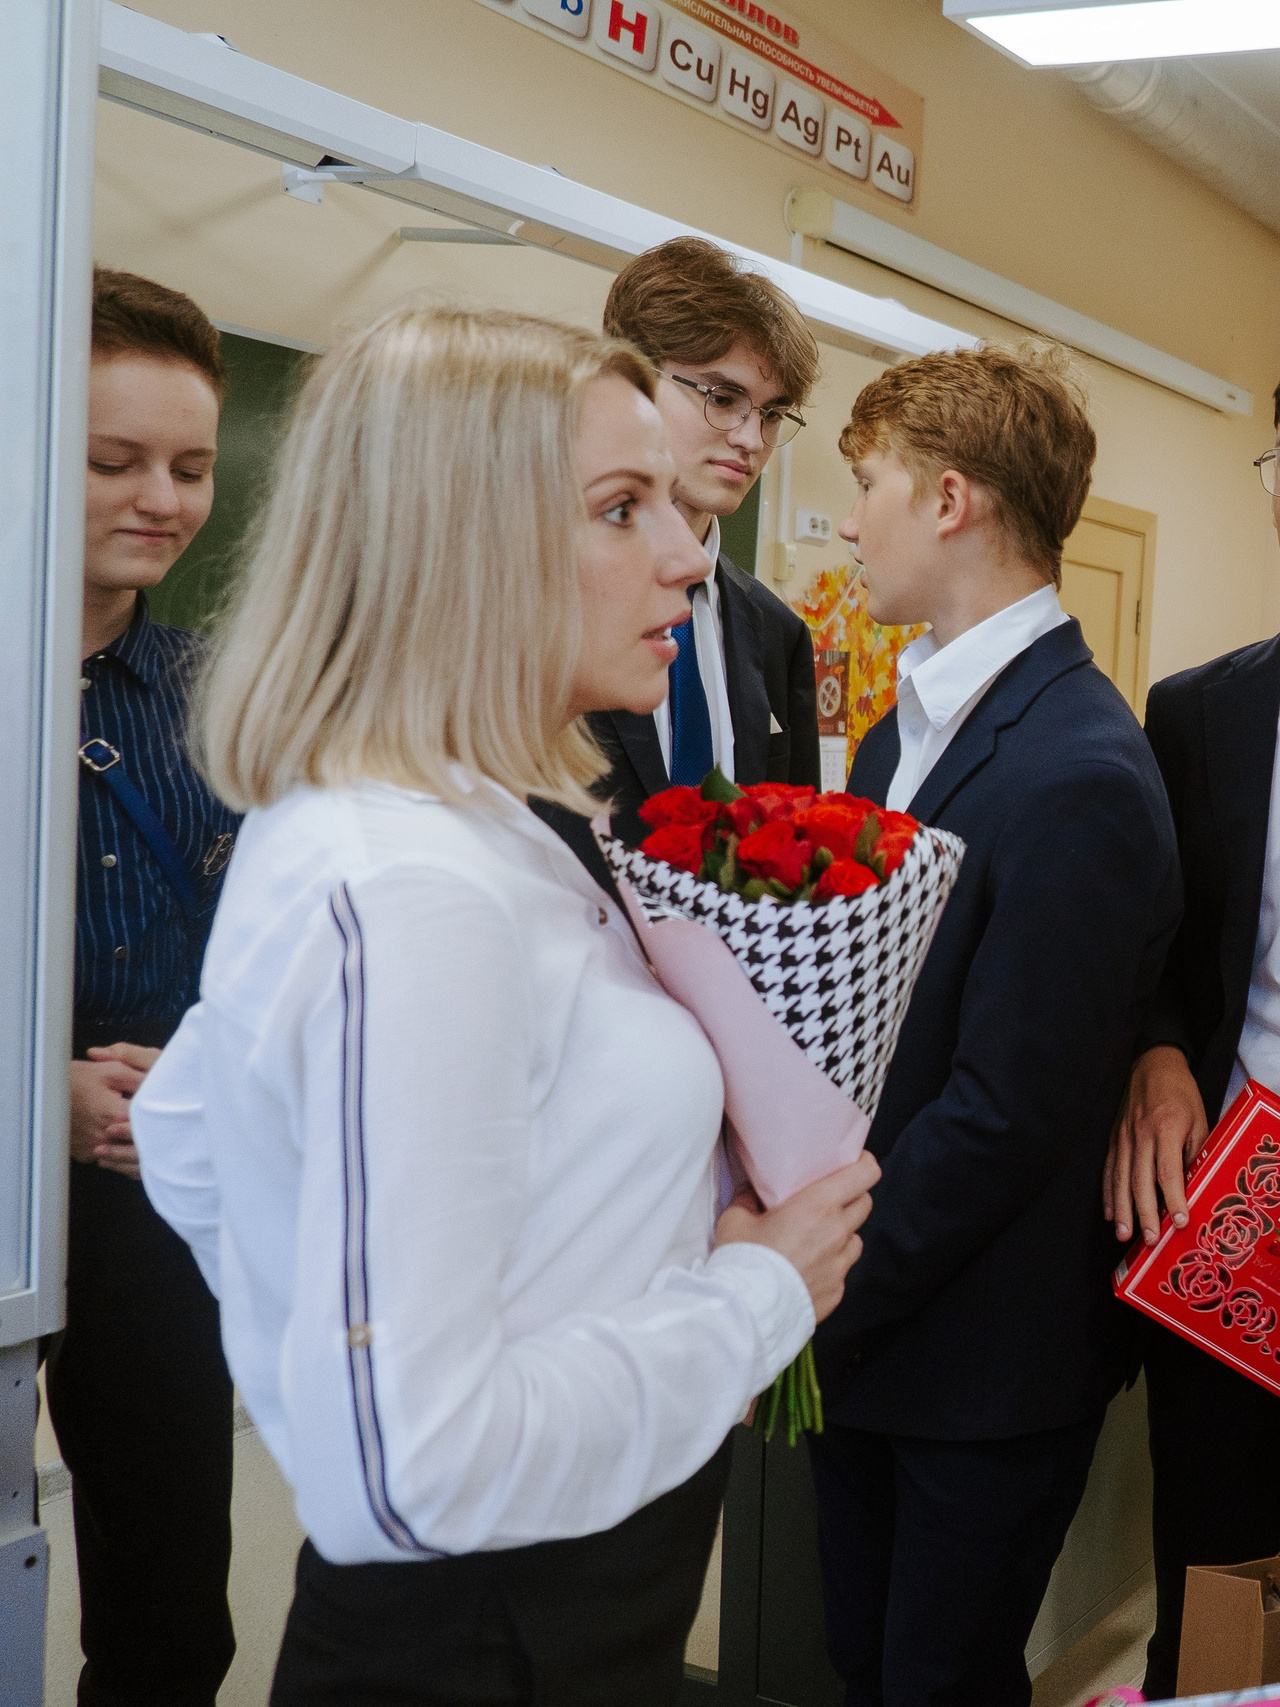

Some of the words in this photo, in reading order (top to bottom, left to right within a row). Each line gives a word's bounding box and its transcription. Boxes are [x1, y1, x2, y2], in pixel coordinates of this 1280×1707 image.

[608, 0, 648, 54] H
[670, 39, 714, 85] Cu
[729, 68, 770, 119] Hg
[781, 100, 820, 146] Ag
[836, 126, 862, 163] Pt
[877, 151, 911, 187] Au
[753, 37, 815, 80] СПОСОБНОСТЬ
[816, 73, 880, 118] УВЕЛИЧИВАЕТСЯ
